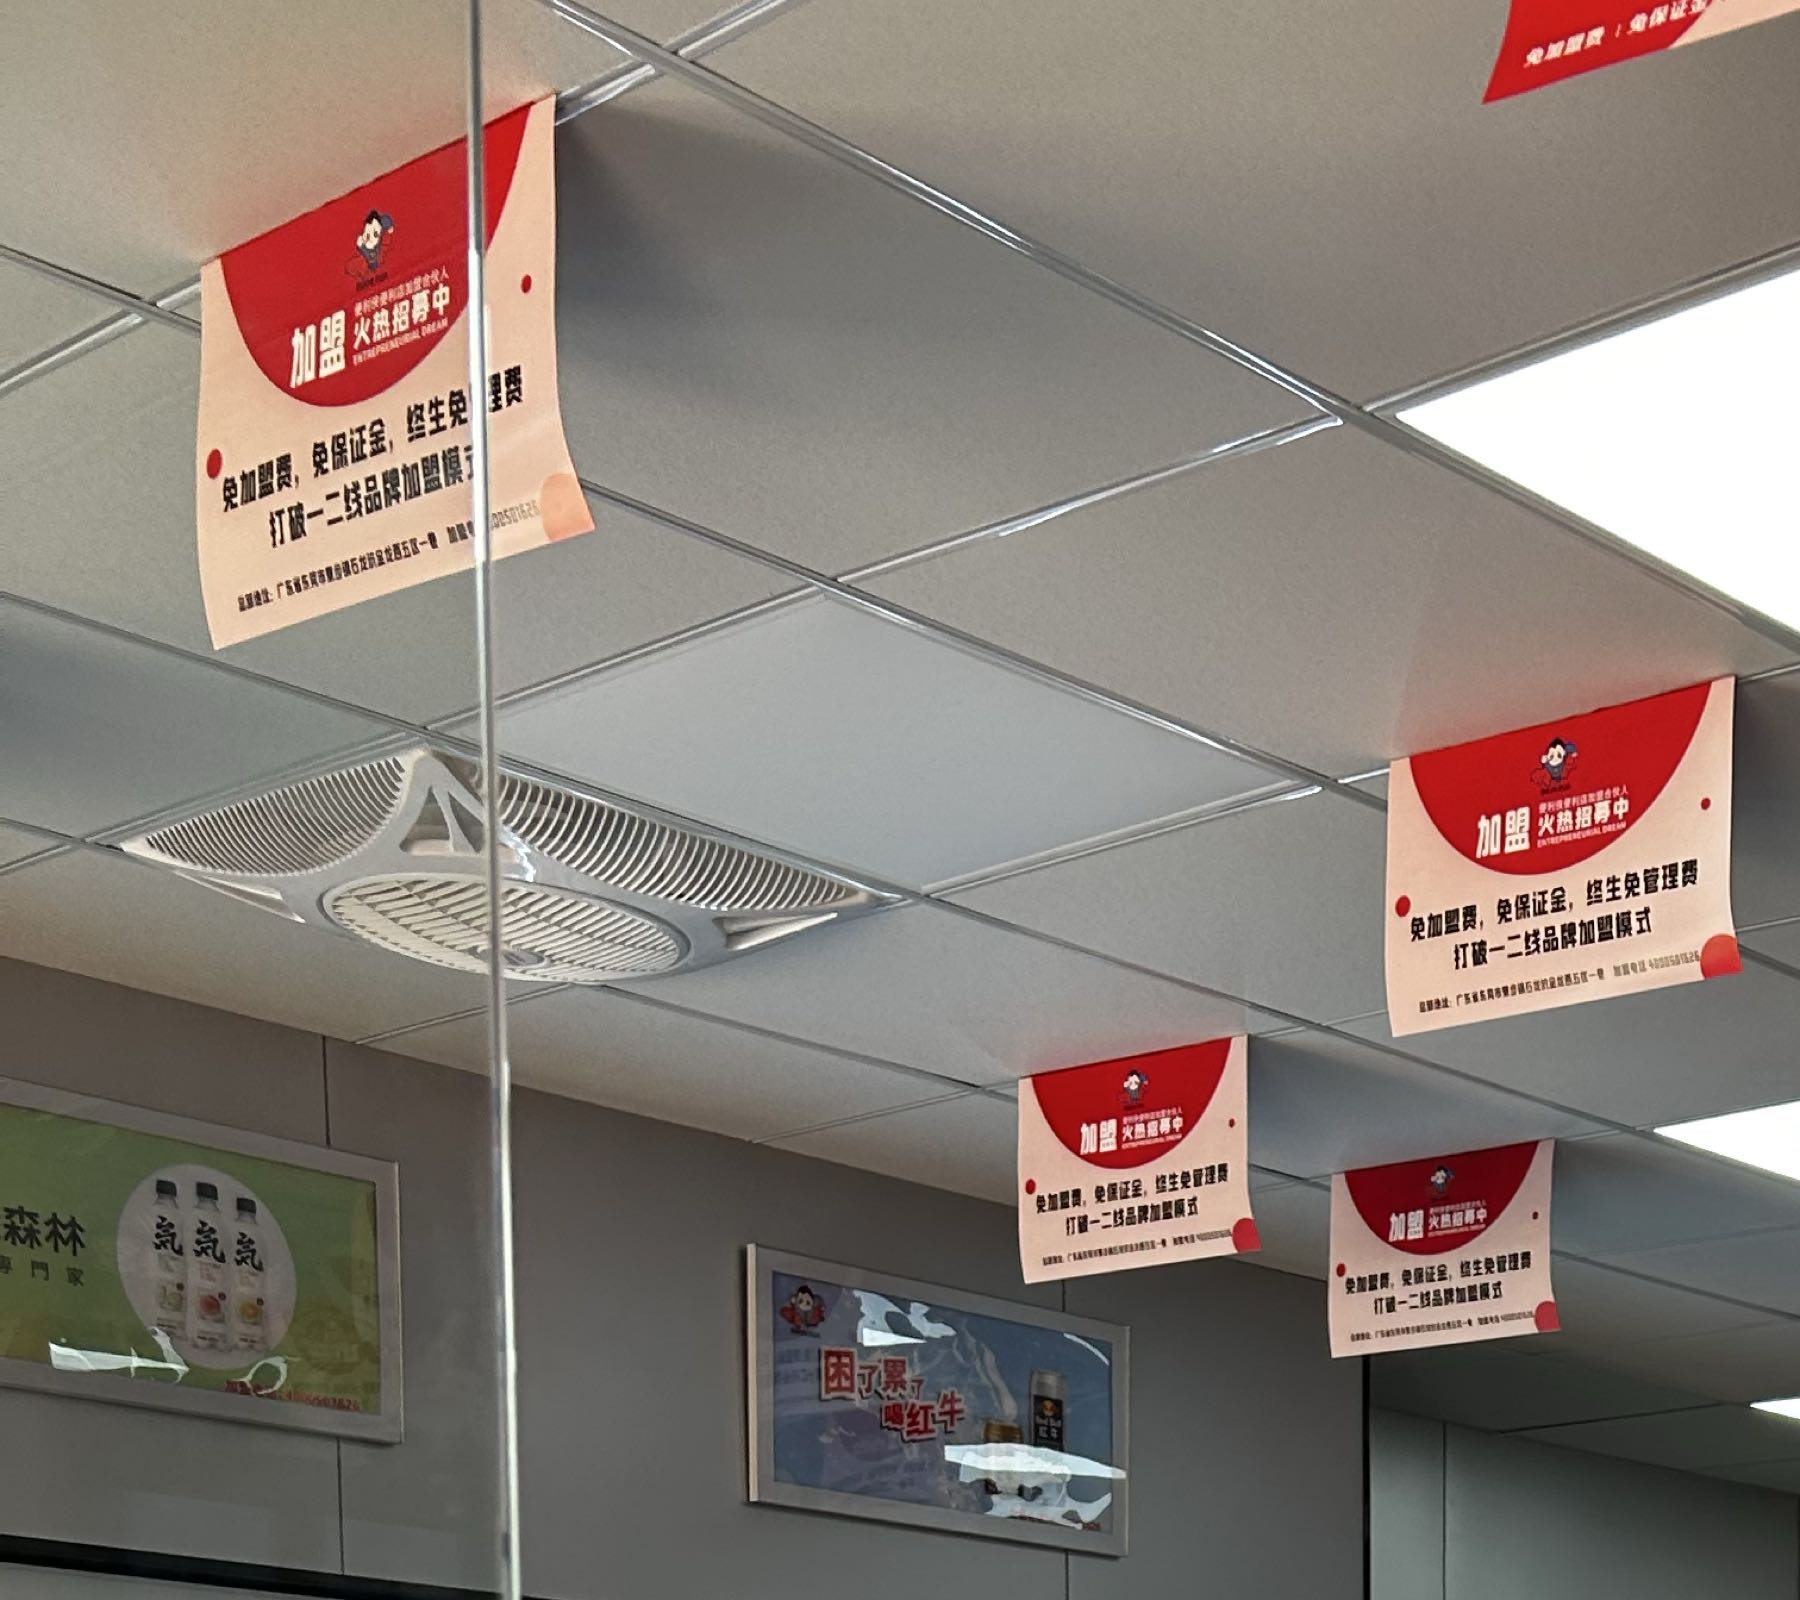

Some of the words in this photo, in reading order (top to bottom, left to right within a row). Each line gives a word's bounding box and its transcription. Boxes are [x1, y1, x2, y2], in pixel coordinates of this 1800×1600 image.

[352, 284, 451, 348] 火热招募中
[290, 310, 346, 388] 加盟
[1475, 806, 1530, 858] 加盟
[1538, 797, 1630, 836] 火热招募中
[1454, 908, 1652, 971] 打破一二线品牌加盟模式
[1080, 1118, 1117, 1156] 加盟
[1389, 1209, 1424, 1242] 加盟
[882, 1390, 966, 1439] 喝红牛
